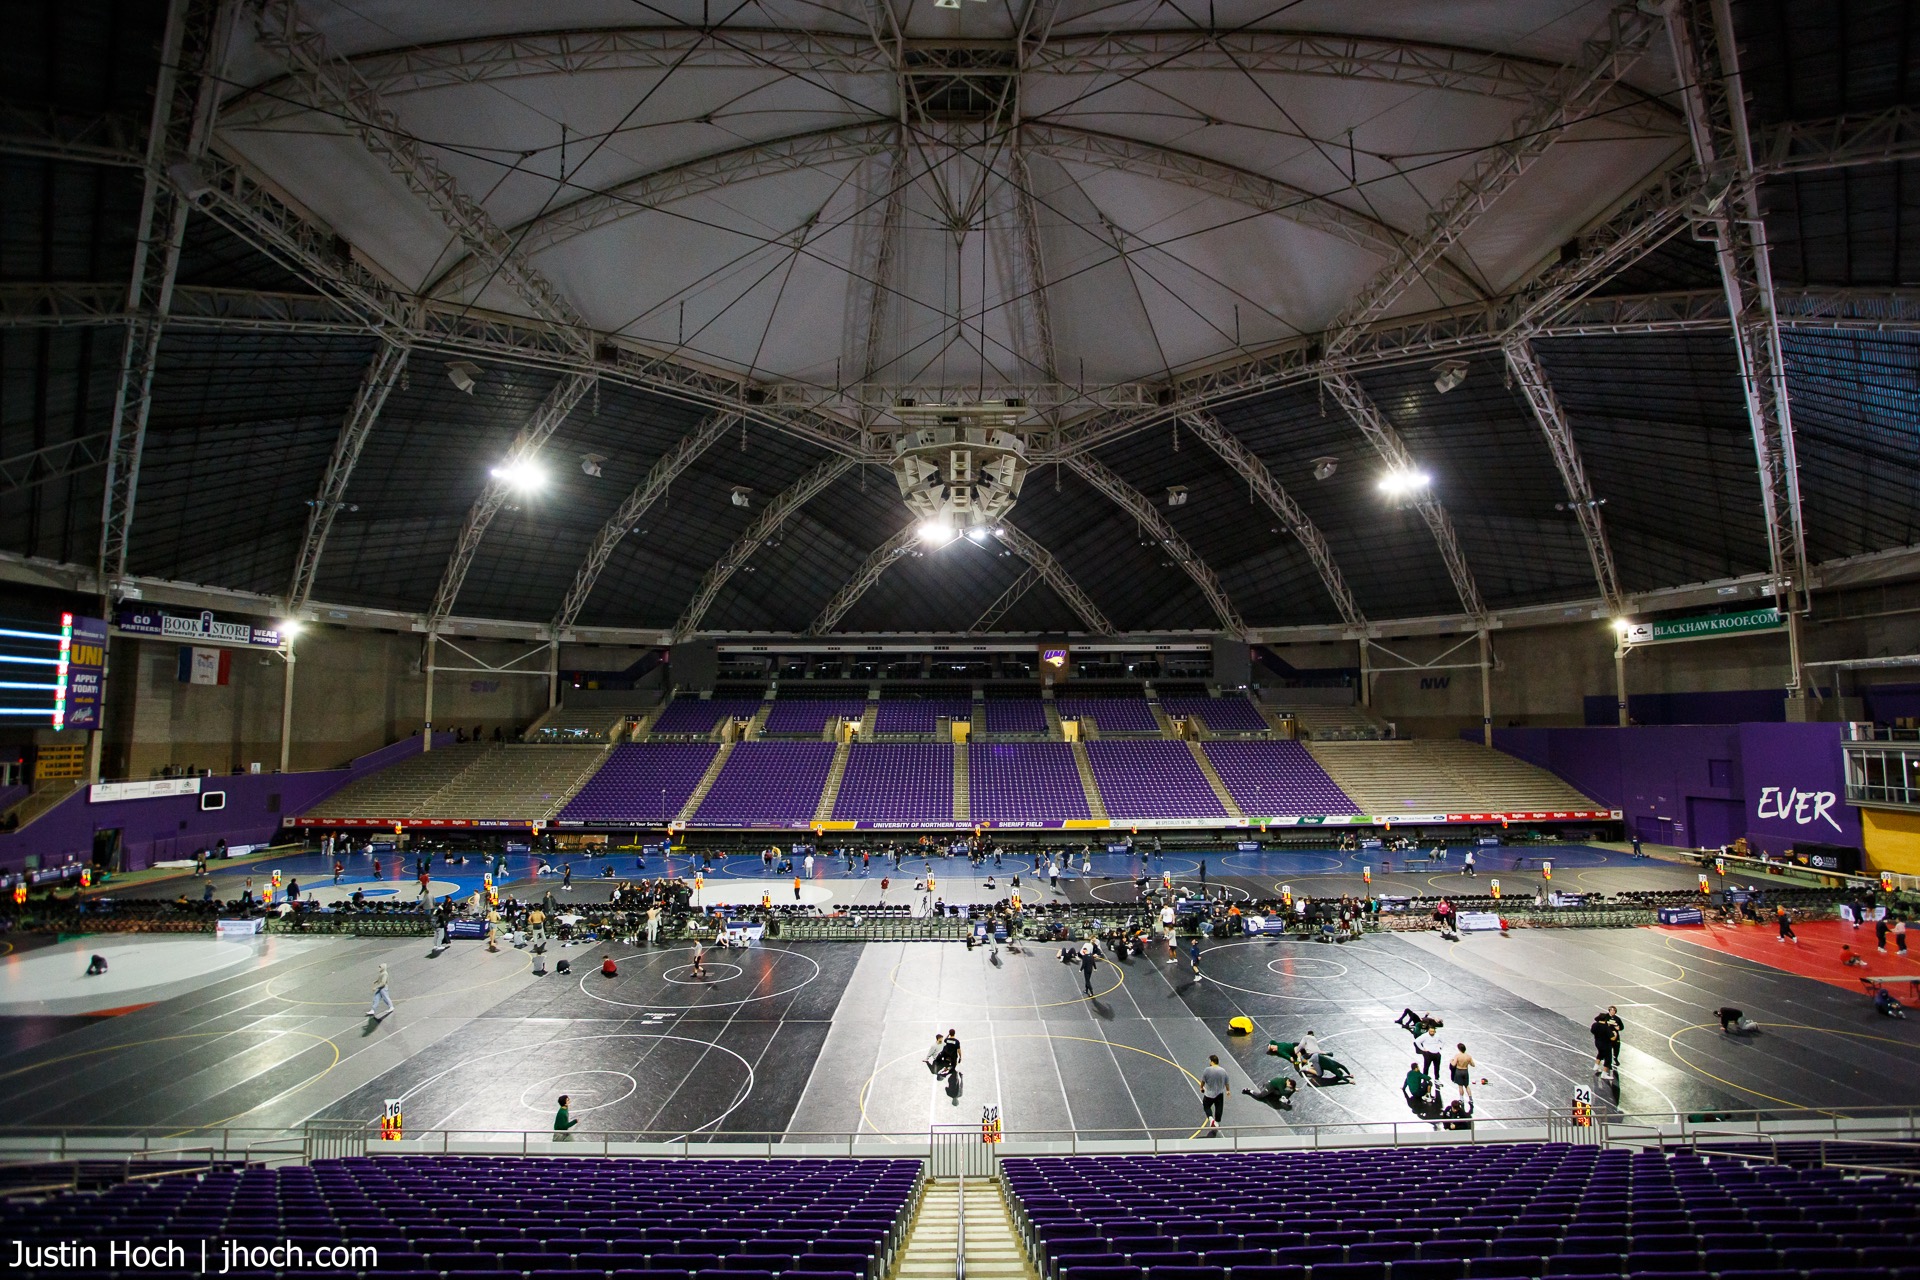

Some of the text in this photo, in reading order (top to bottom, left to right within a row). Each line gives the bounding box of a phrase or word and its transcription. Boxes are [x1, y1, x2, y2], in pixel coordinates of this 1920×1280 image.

[133, 614, 150, 625] GO
[1654, 612, 1779, 636] BLACKHAWKROOF.COM
[121, 624, 161, 632] PANTHERS!
[164, 617, 250, 637] BOOK STORE
[254, 629, 278, 638] WEAR
[71, 644, 103, 666] UNI
[75, 674, 97, 683] APPLY
[1420, 677, 1450, 689] NW
[72, 685, 98, 693] TODAY!
[1758, 787, 1842, 833] EVER
[1576, 1088, 1590, 1102] 24
[389, 1102, 400, 1116] 16
[991, 1106, 997, 1121] 22
